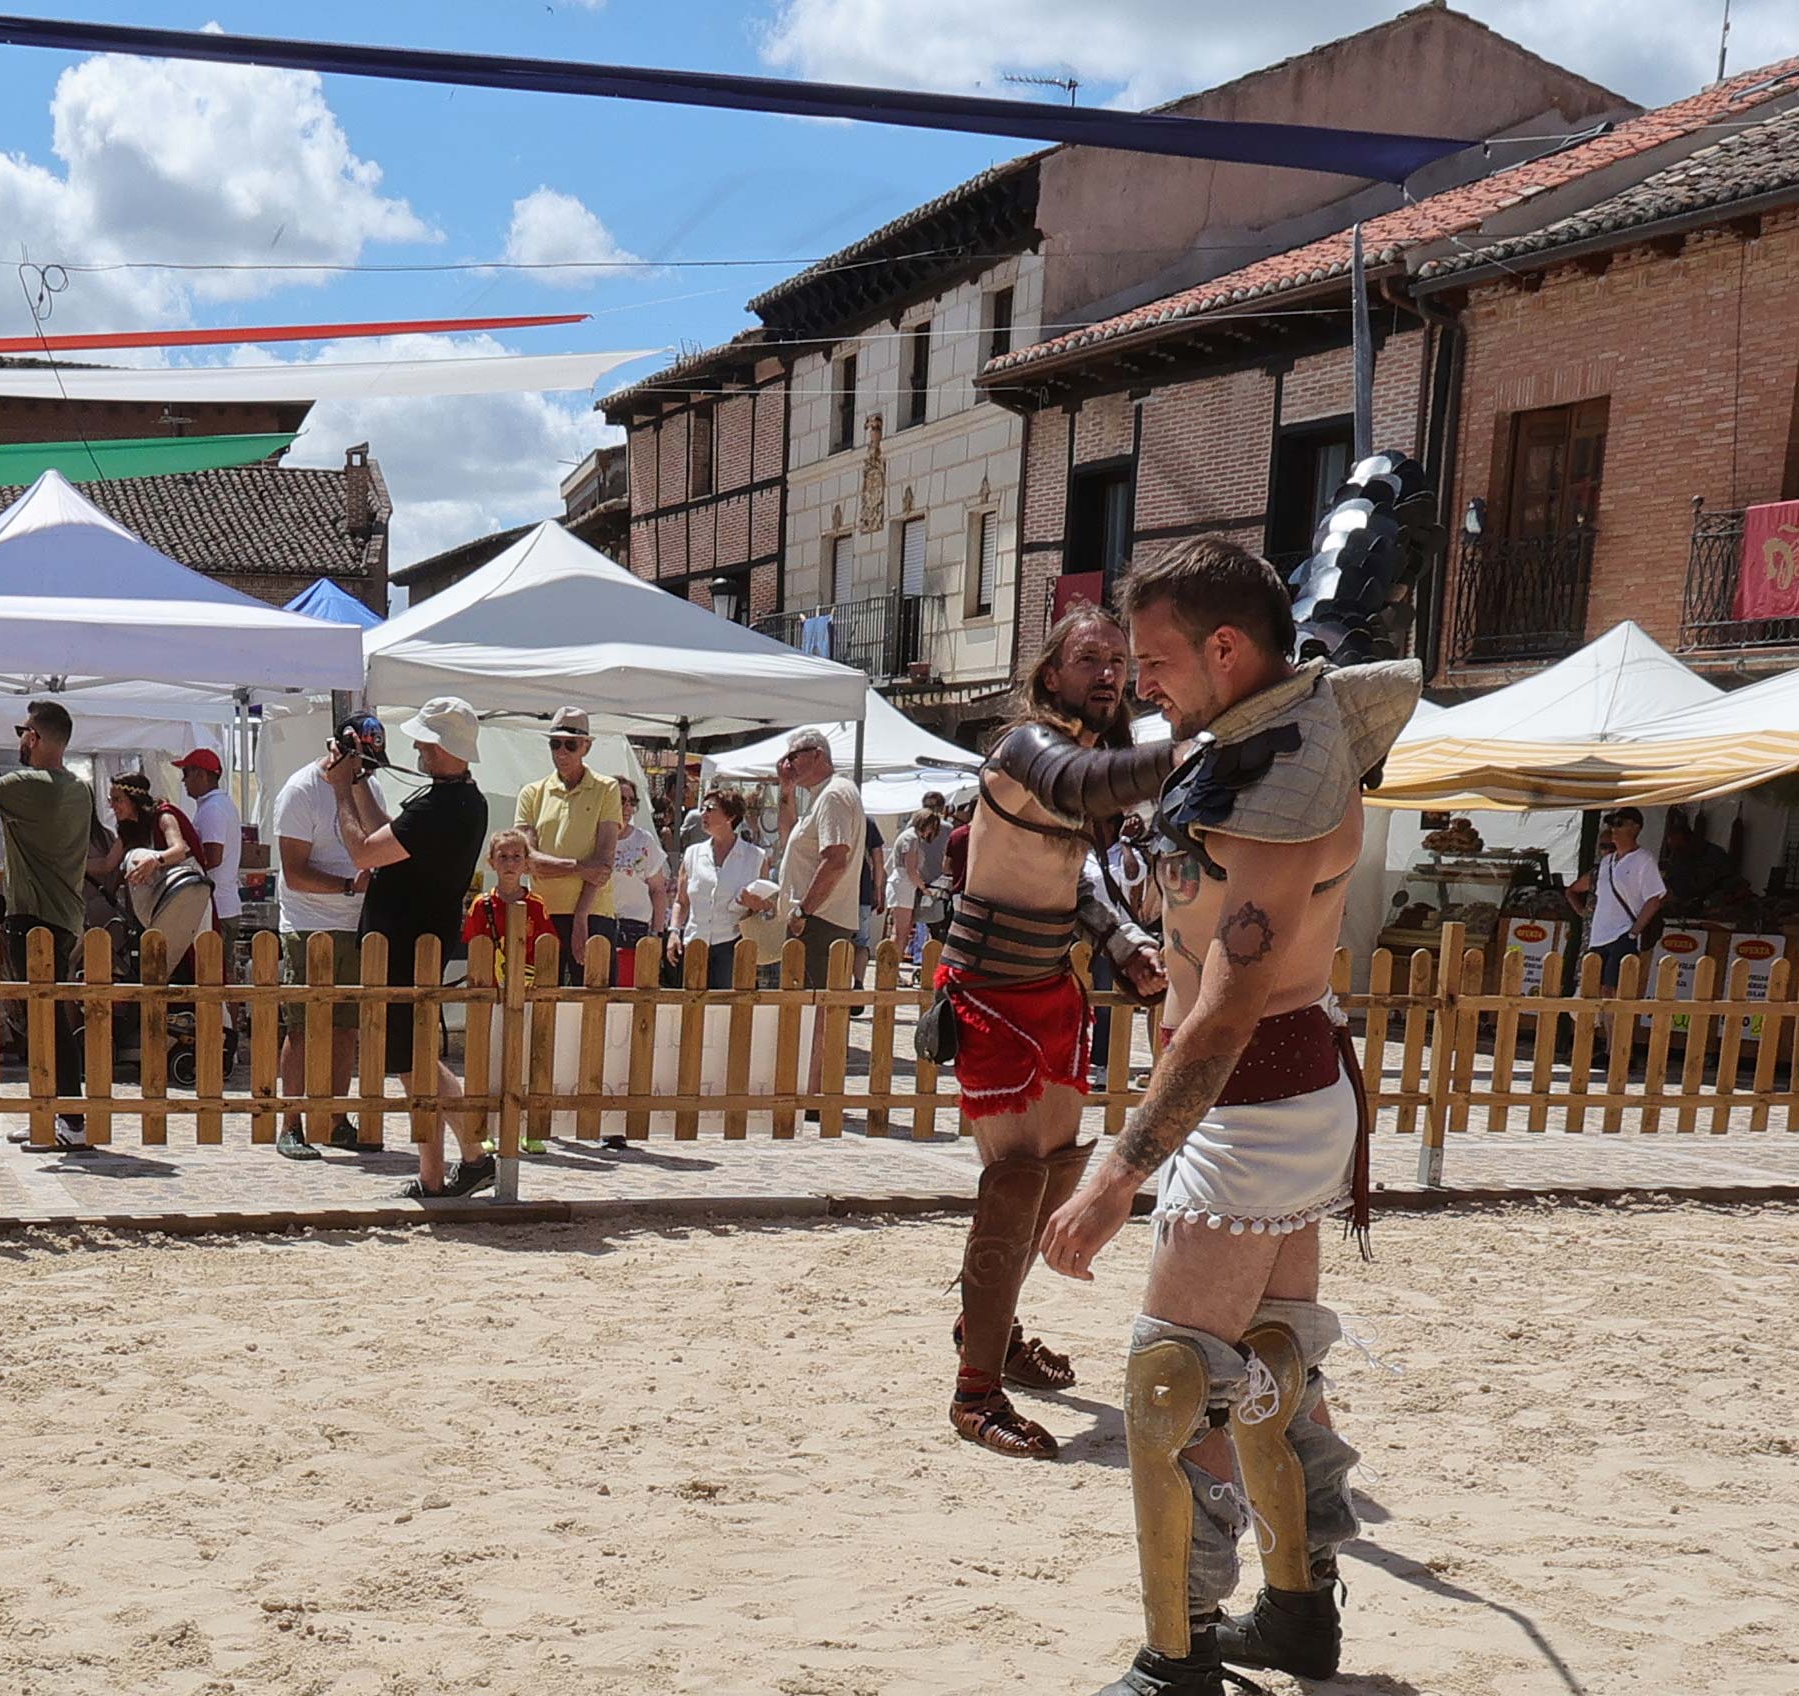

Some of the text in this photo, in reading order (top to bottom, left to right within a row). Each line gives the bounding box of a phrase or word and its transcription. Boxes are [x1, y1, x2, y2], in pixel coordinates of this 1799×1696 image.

[1515, 928, 1544, 939] OFERTA
[1663, 938, 1694, 949] OFERTA
[1738, 945, 1770, 955] OFERTA
